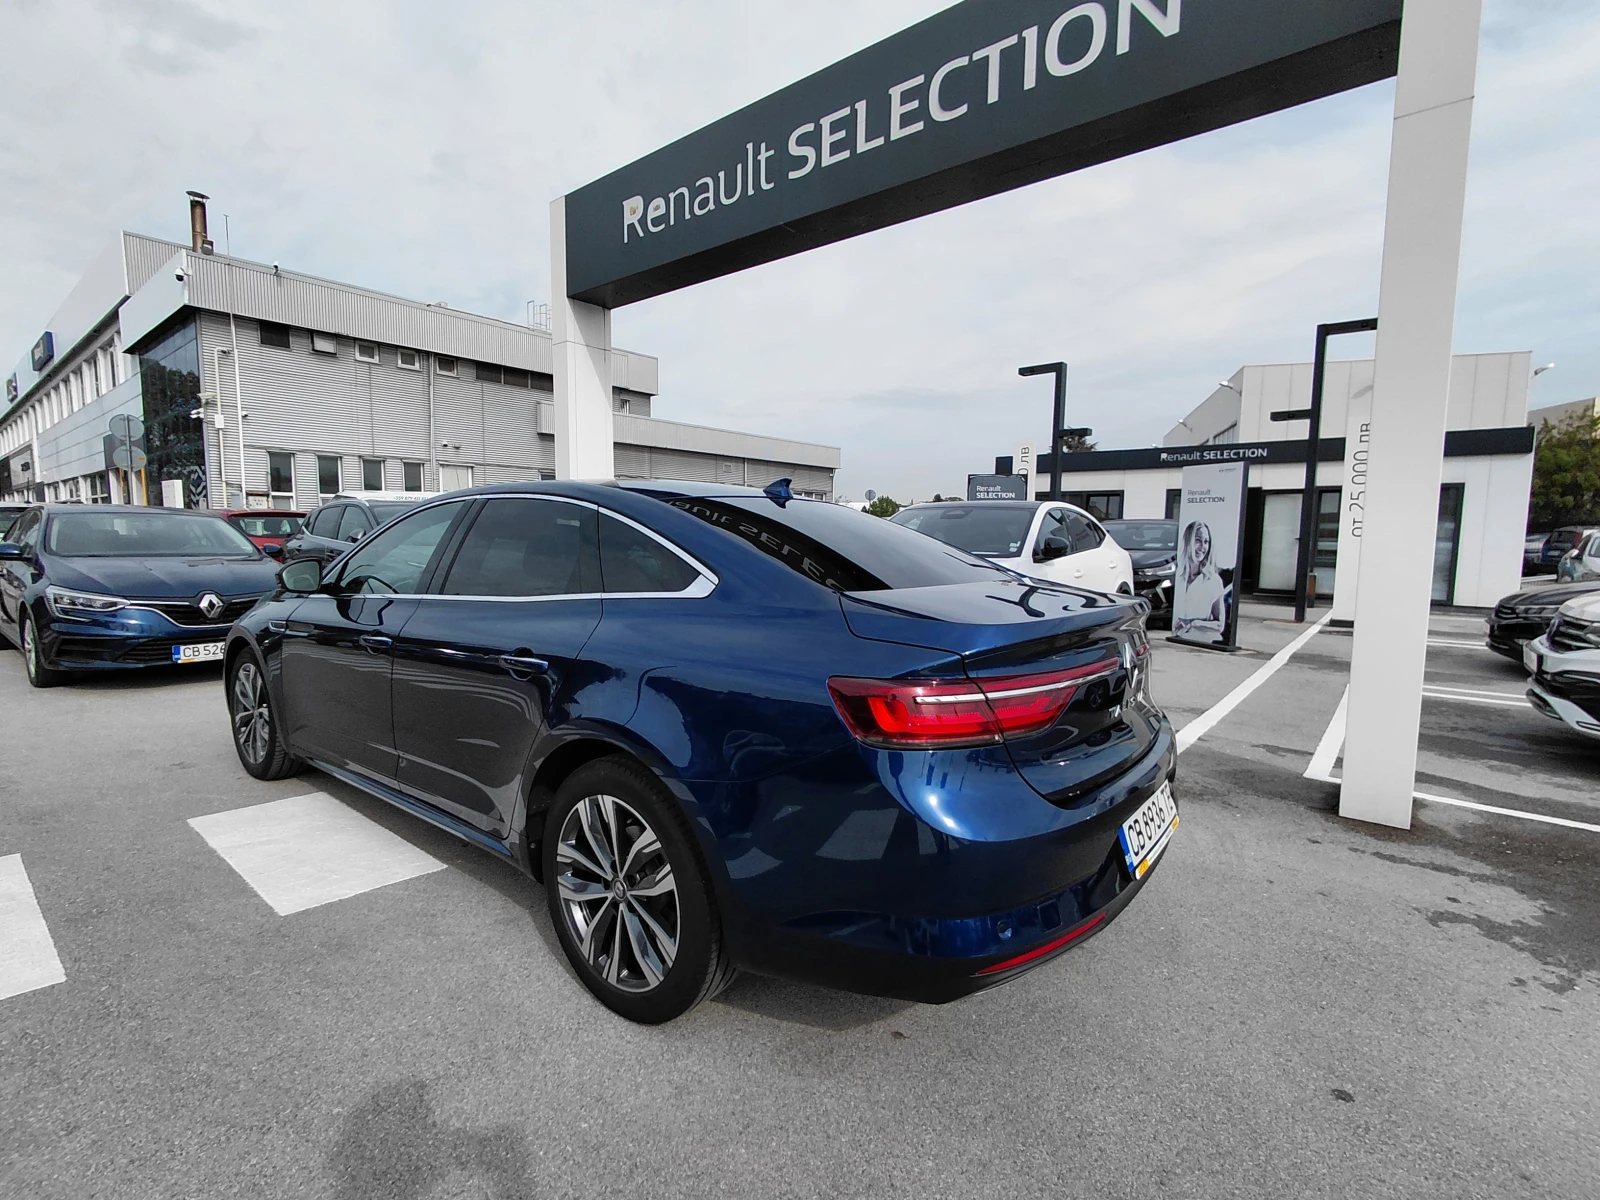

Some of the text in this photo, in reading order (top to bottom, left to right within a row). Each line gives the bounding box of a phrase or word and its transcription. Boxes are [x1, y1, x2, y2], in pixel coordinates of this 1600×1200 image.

[622, 0, 1181, 243] Renault SELECTION
[1160, 448, 1268, 462] Renault SELECTION
[1187, 496, 1225, 504] SELECTION
[183, 646, 200, 658] CB
[1127, 818, 1146, 857] CB
[1142, 794, 1165, 841] 8936
